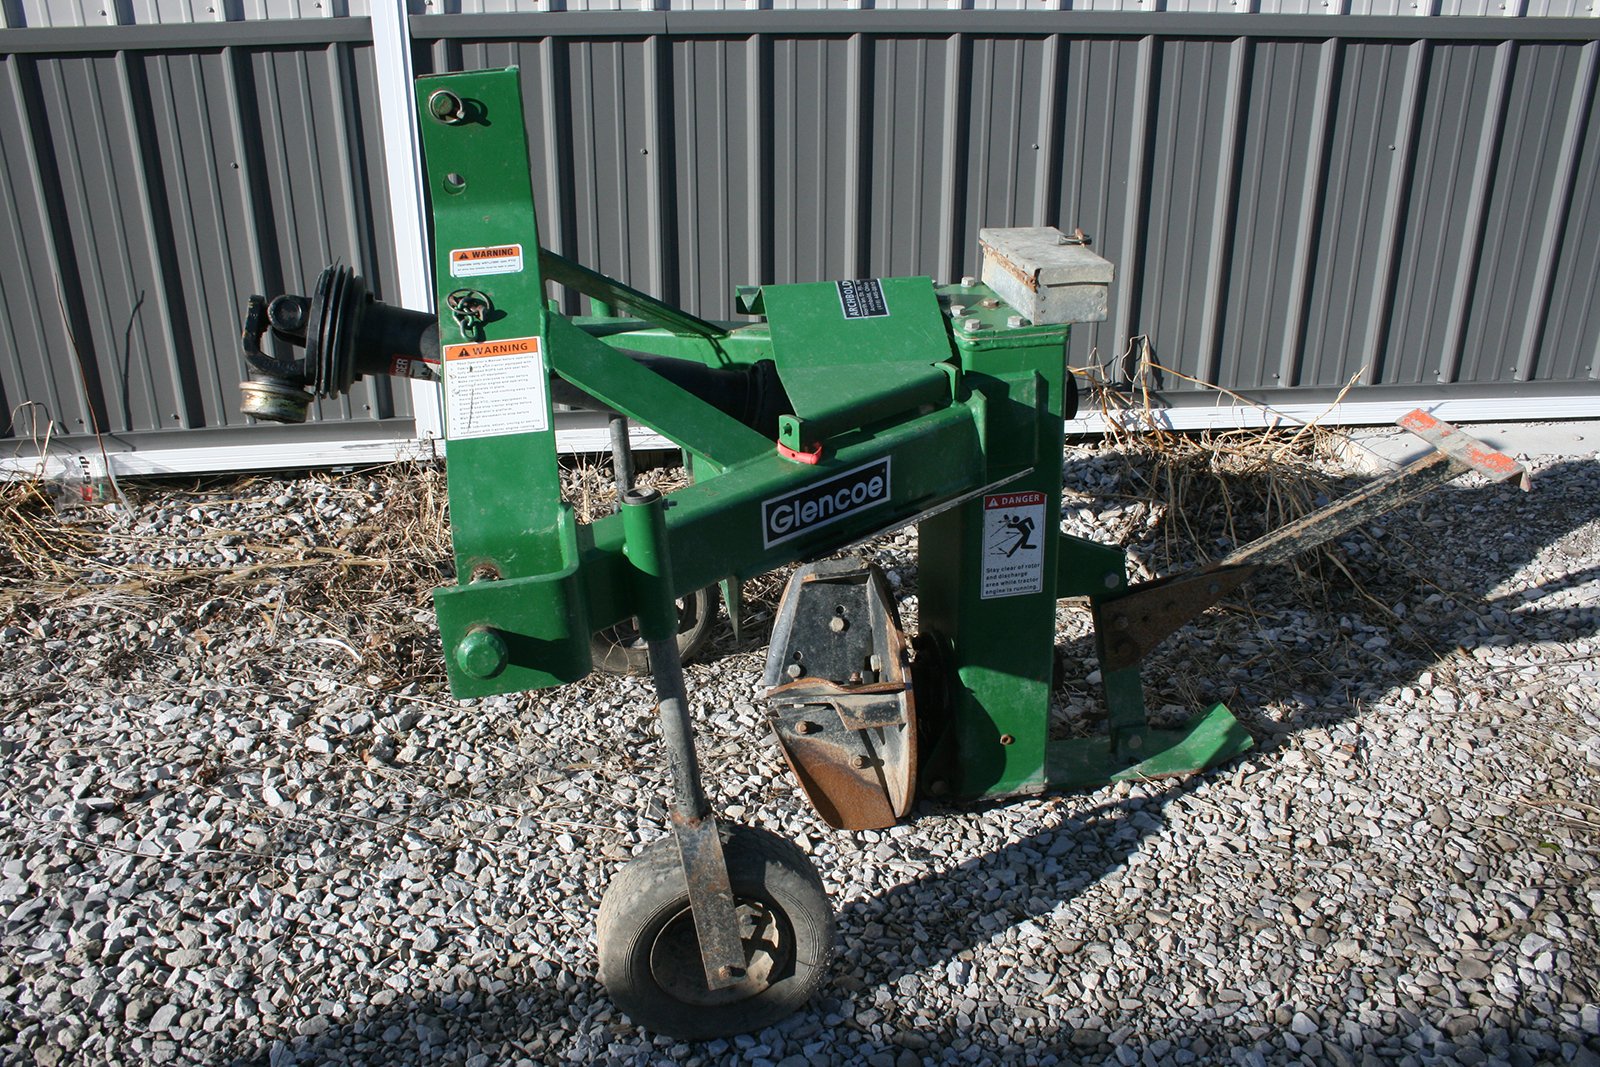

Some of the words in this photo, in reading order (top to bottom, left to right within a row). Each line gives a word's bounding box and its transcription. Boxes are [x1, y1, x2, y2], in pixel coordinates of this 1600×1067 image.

[472, 248, 513, 258] WARNING
[842, 280, 860, 316] ARCHBOLD
[472, 342, 528, 355] WARNING
[770, 476, 883, 533] Glencoe
[1001, 494, 1040, 505] DANGER
[1013, 584, 1038, 592] running.
